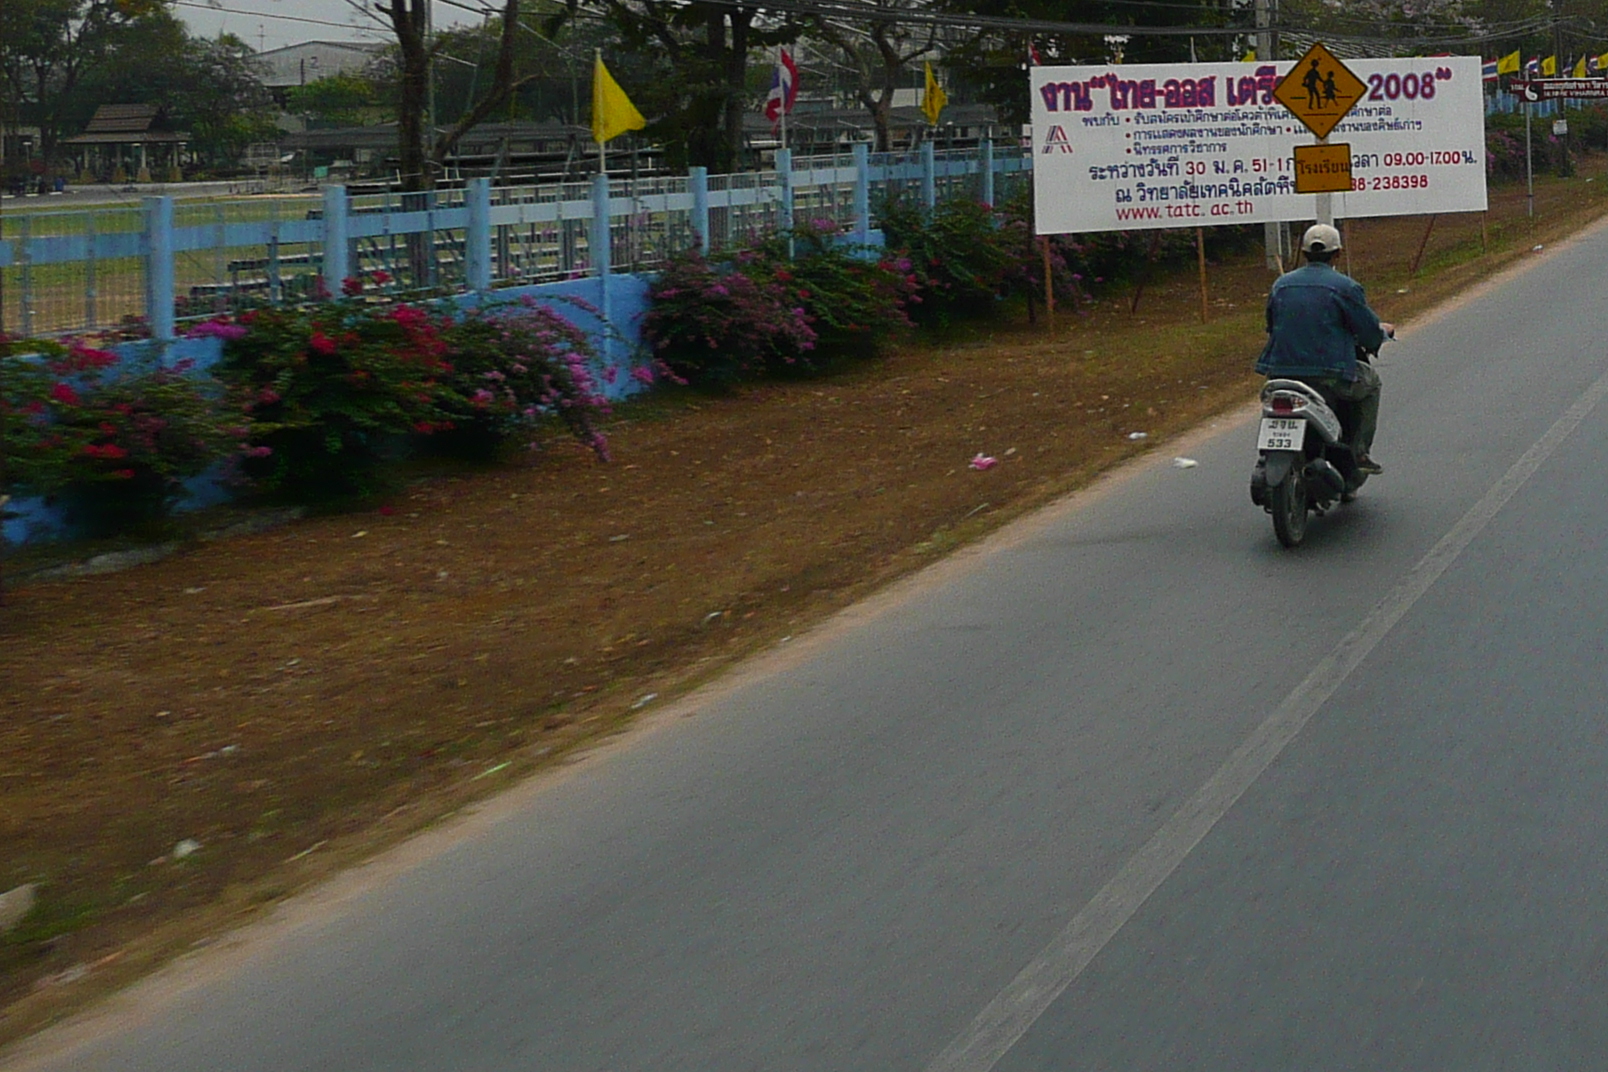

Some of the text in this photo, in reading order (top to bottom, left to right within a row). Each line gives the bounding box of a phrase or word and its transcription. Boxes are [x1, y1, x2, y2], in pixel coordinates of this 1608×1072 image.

[1082, 112, 1120, 127] พบกับ
[1133, 141, 1227, 156] นิทรรศการวิชาการ
[1089, 155, 1180, 180] ระหว่างวันที่
[1185, 161, 1206, 175] 30
[1352, 153, 1379, 168] วลา
[1297, 159, 1350, 175] โรงเรียน
[1267, 438, 1292, 448] 533
